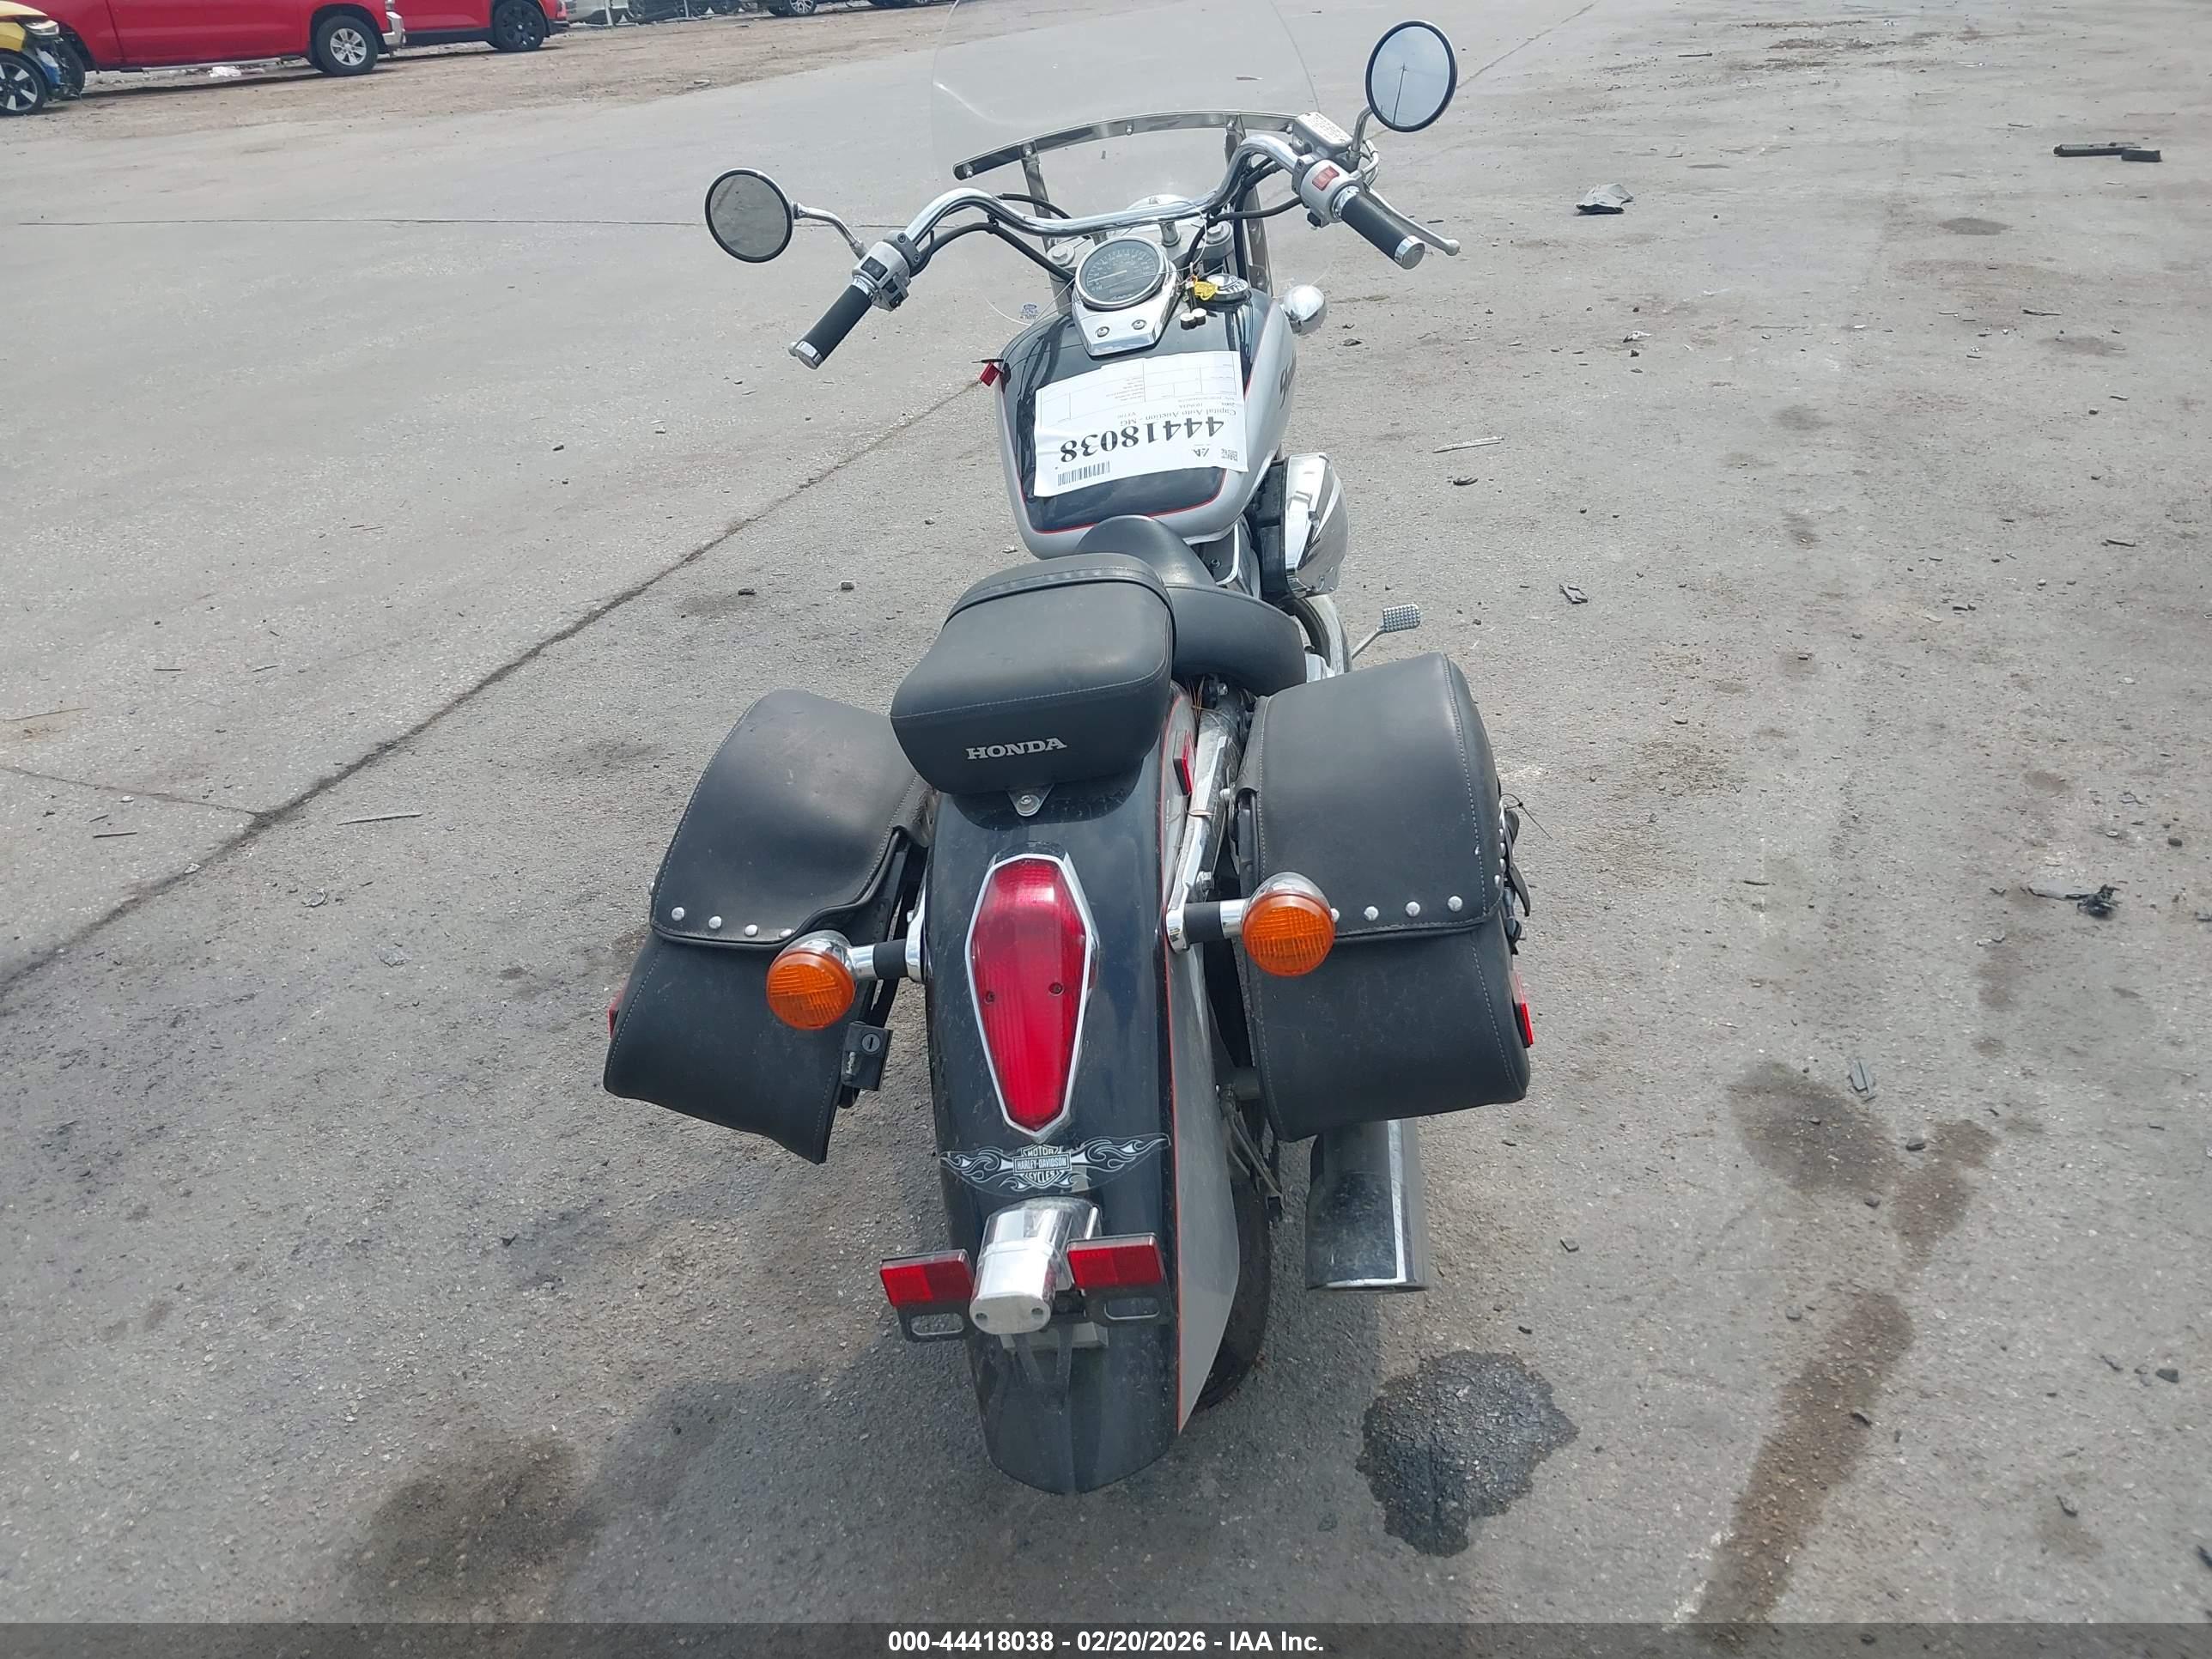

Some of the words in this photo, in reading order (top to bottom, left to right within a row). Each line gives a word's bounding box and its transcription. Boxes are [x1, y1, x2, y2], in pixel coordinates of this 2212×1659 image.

[1146, 411, 1180, 421] Auction
[1206, 408, 1237, 416] Capital
[1060, 416, 1224, 463] 44418038
[966, 738, 1067, 760] HONDA
[1027, 1146, 1054, 1157] MOTOR
[1017, 1157, 1066, 1170] HARLEY-DAVIDSON
[1029, 1170, 1055, 1183] CYCLES
